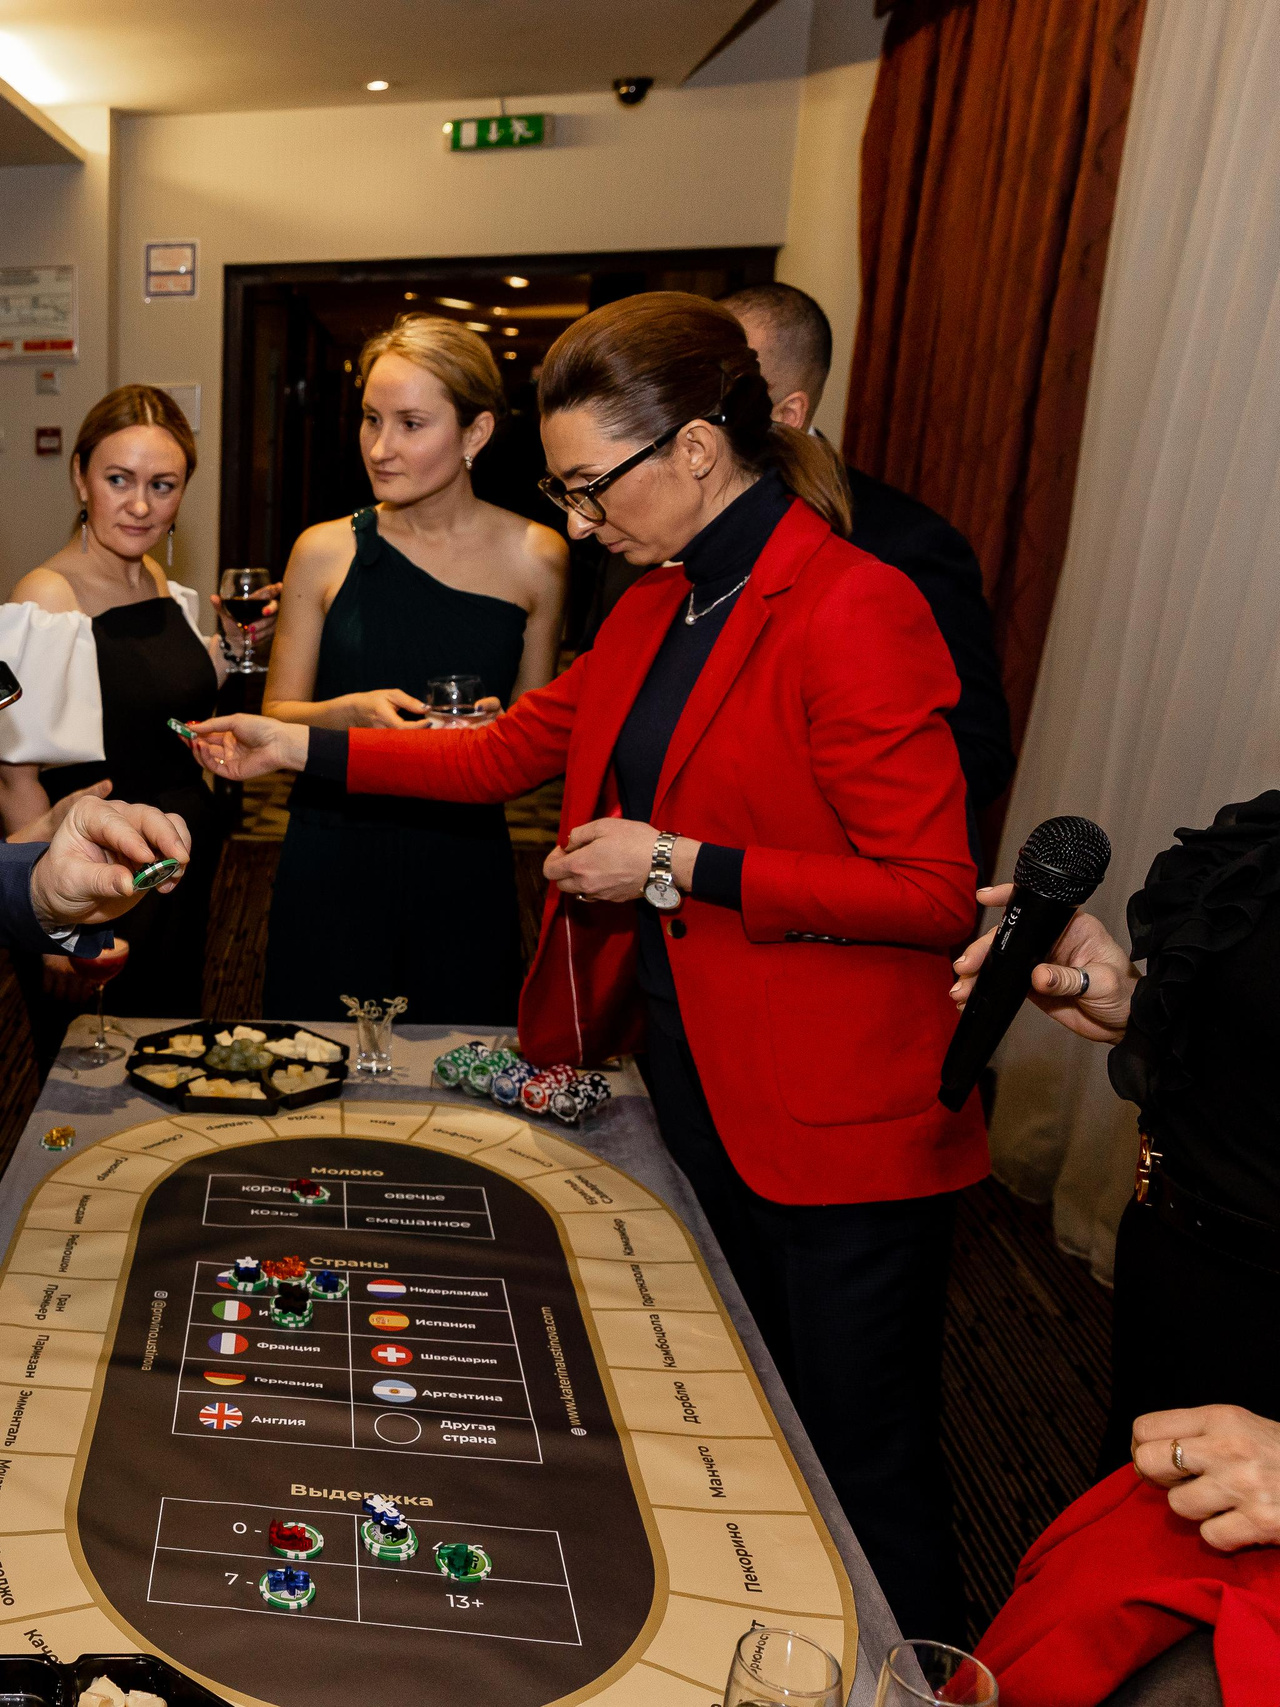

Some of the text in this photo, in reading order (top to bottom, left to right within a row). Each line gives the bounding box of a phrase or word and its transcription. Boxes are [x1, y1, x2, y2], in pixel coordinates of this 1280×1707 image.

[310, 1166, 385, 1178] Молоко
[241, 1185, 292, 1194] коров
[384, 1192, 446, 1202] овечье
[250, 1208, 299, 1217] козье
[366, 1216, 471, 1228] смешанное
[614, 1218, 635, 1256] Камамбер
[58, 1234, 80, 1273] Реблошон
[310, 1256, 390, 1269] Страны
[410, 1286, 489, 1298] Нидерланды
[630, 1264, 656, 1308] Горгонзола
[34, 1284, 58, 1320] Премьер
[56, 1294, 72, 1312] Гран
[415, 1318, 476, 1330] Испания
[141, 1300, 167, 1371] @provino.ustinova
[649, 1314, 678, 1368] Камбоцола
[256, 1342, 321, 1353] Франция
[24, 1334, 50, 1378] Пармезан
[420, 1352, 498, 1365] Швейцария
[541, 1306, 582, 1426] www.katerinaustinova.com
[253, 1376, 324, 1390] Германия
[422, 1390, 504, 1402] Аргентина
[674, 1380, 702, 1425] Дорблю
[4, 1390, 33, 1448] Эмменталь
[250, 1414, 306, 1428] Англия
[440, 1420, 496, 1432] Другая
[442, 1434, 497, 1445] страна
[698, 1444, 726, 1498] Манчего
[725, 1521, 762, 1594] Пекорино
[224, 1572, 239, 1586] 7
[445, 1593, 484, 1609] 13+
[23, 1628, 63, 1664] Качо
